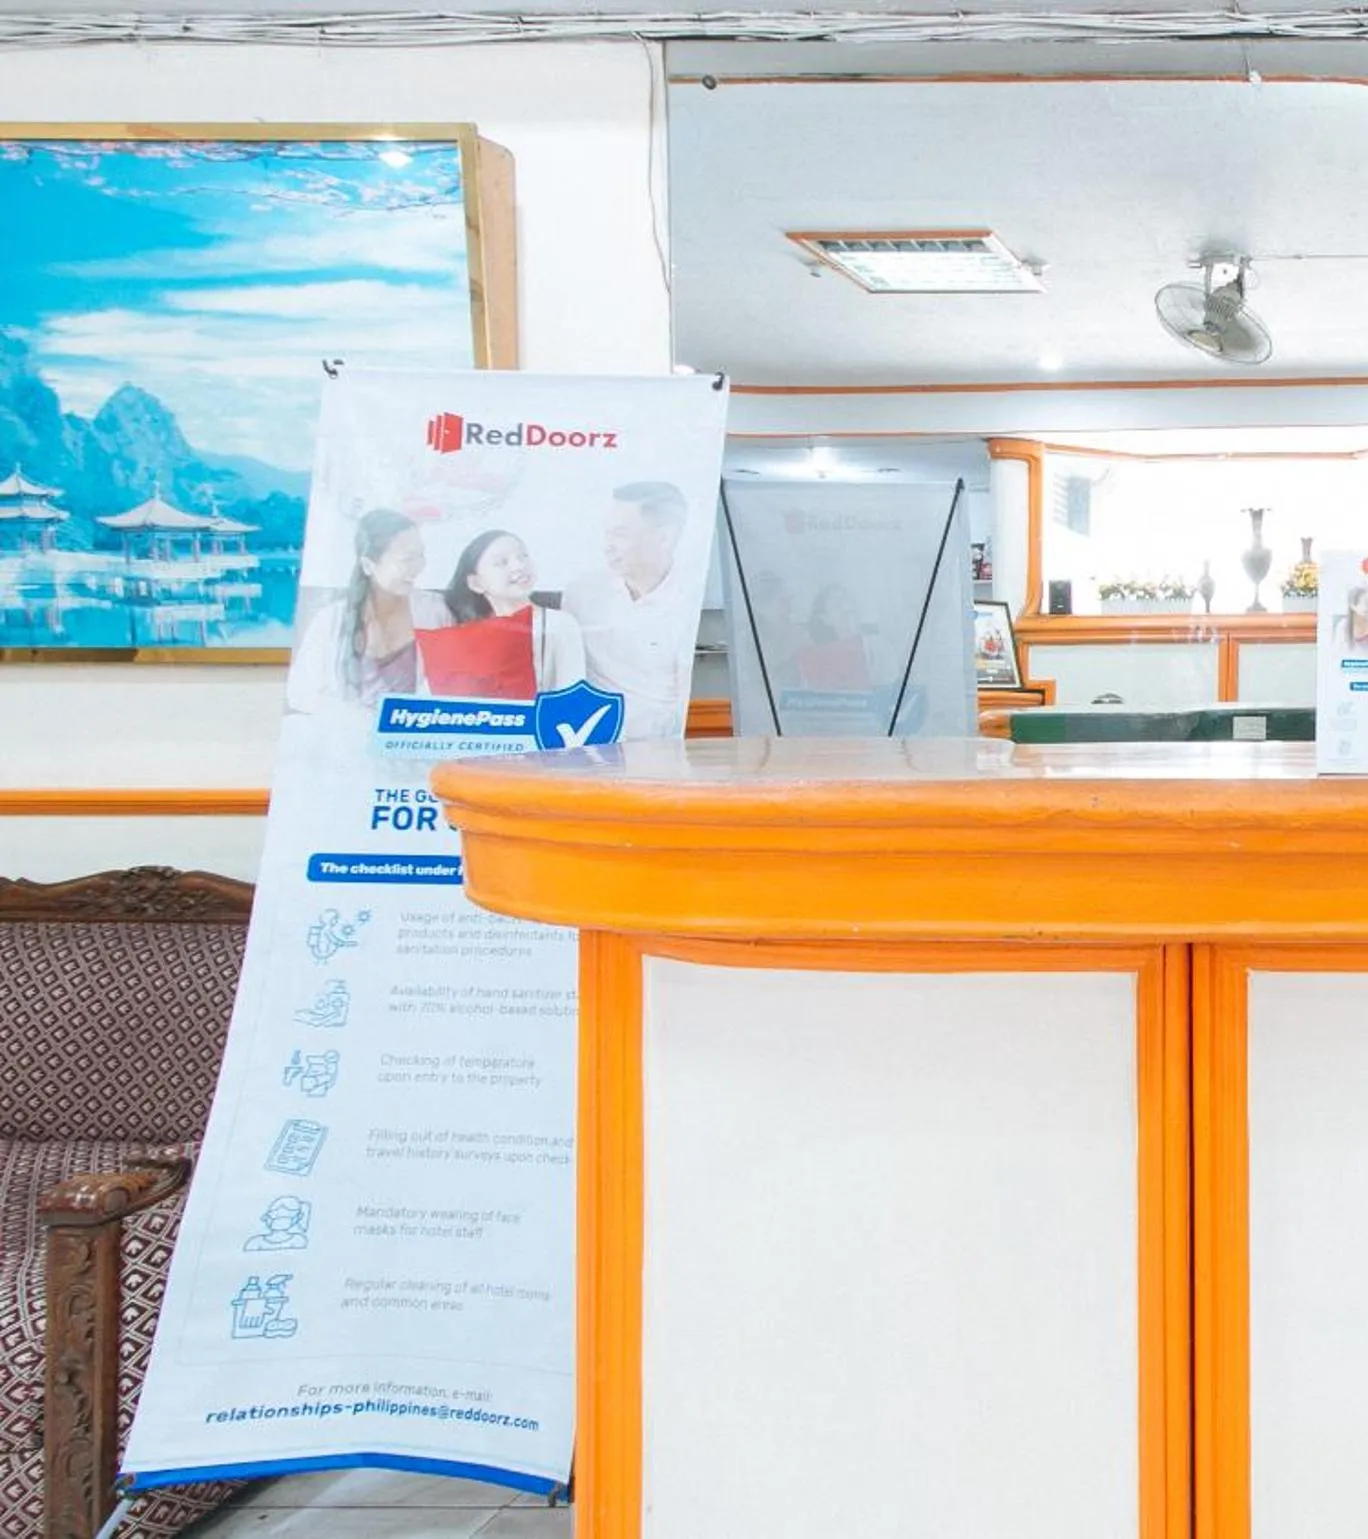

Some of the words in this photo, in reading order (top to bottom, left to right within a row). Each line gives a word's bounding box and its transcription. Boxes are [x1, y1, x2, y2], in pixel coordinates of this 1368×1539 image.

[465, 420, 619, 450] RedDoorz
[389, 708, 527, 729] HygienePass
[384, 740, 454, 751] OFFICIALLY
[458, 741, 525, 752] CERTIFIED
[375, 788, 411, 803] THE
[371, 805, 439, 831] FOR
[320, 861, 349, 874] The
[350, 862, 415, 876] checklist
[415, 864, 456, 876] under
[297, 1382, 325, 1398] For
[328, 1382, 370, 1397] more
[204, 1398, 541, 1432] relationships-philippines@reddoorz.com
